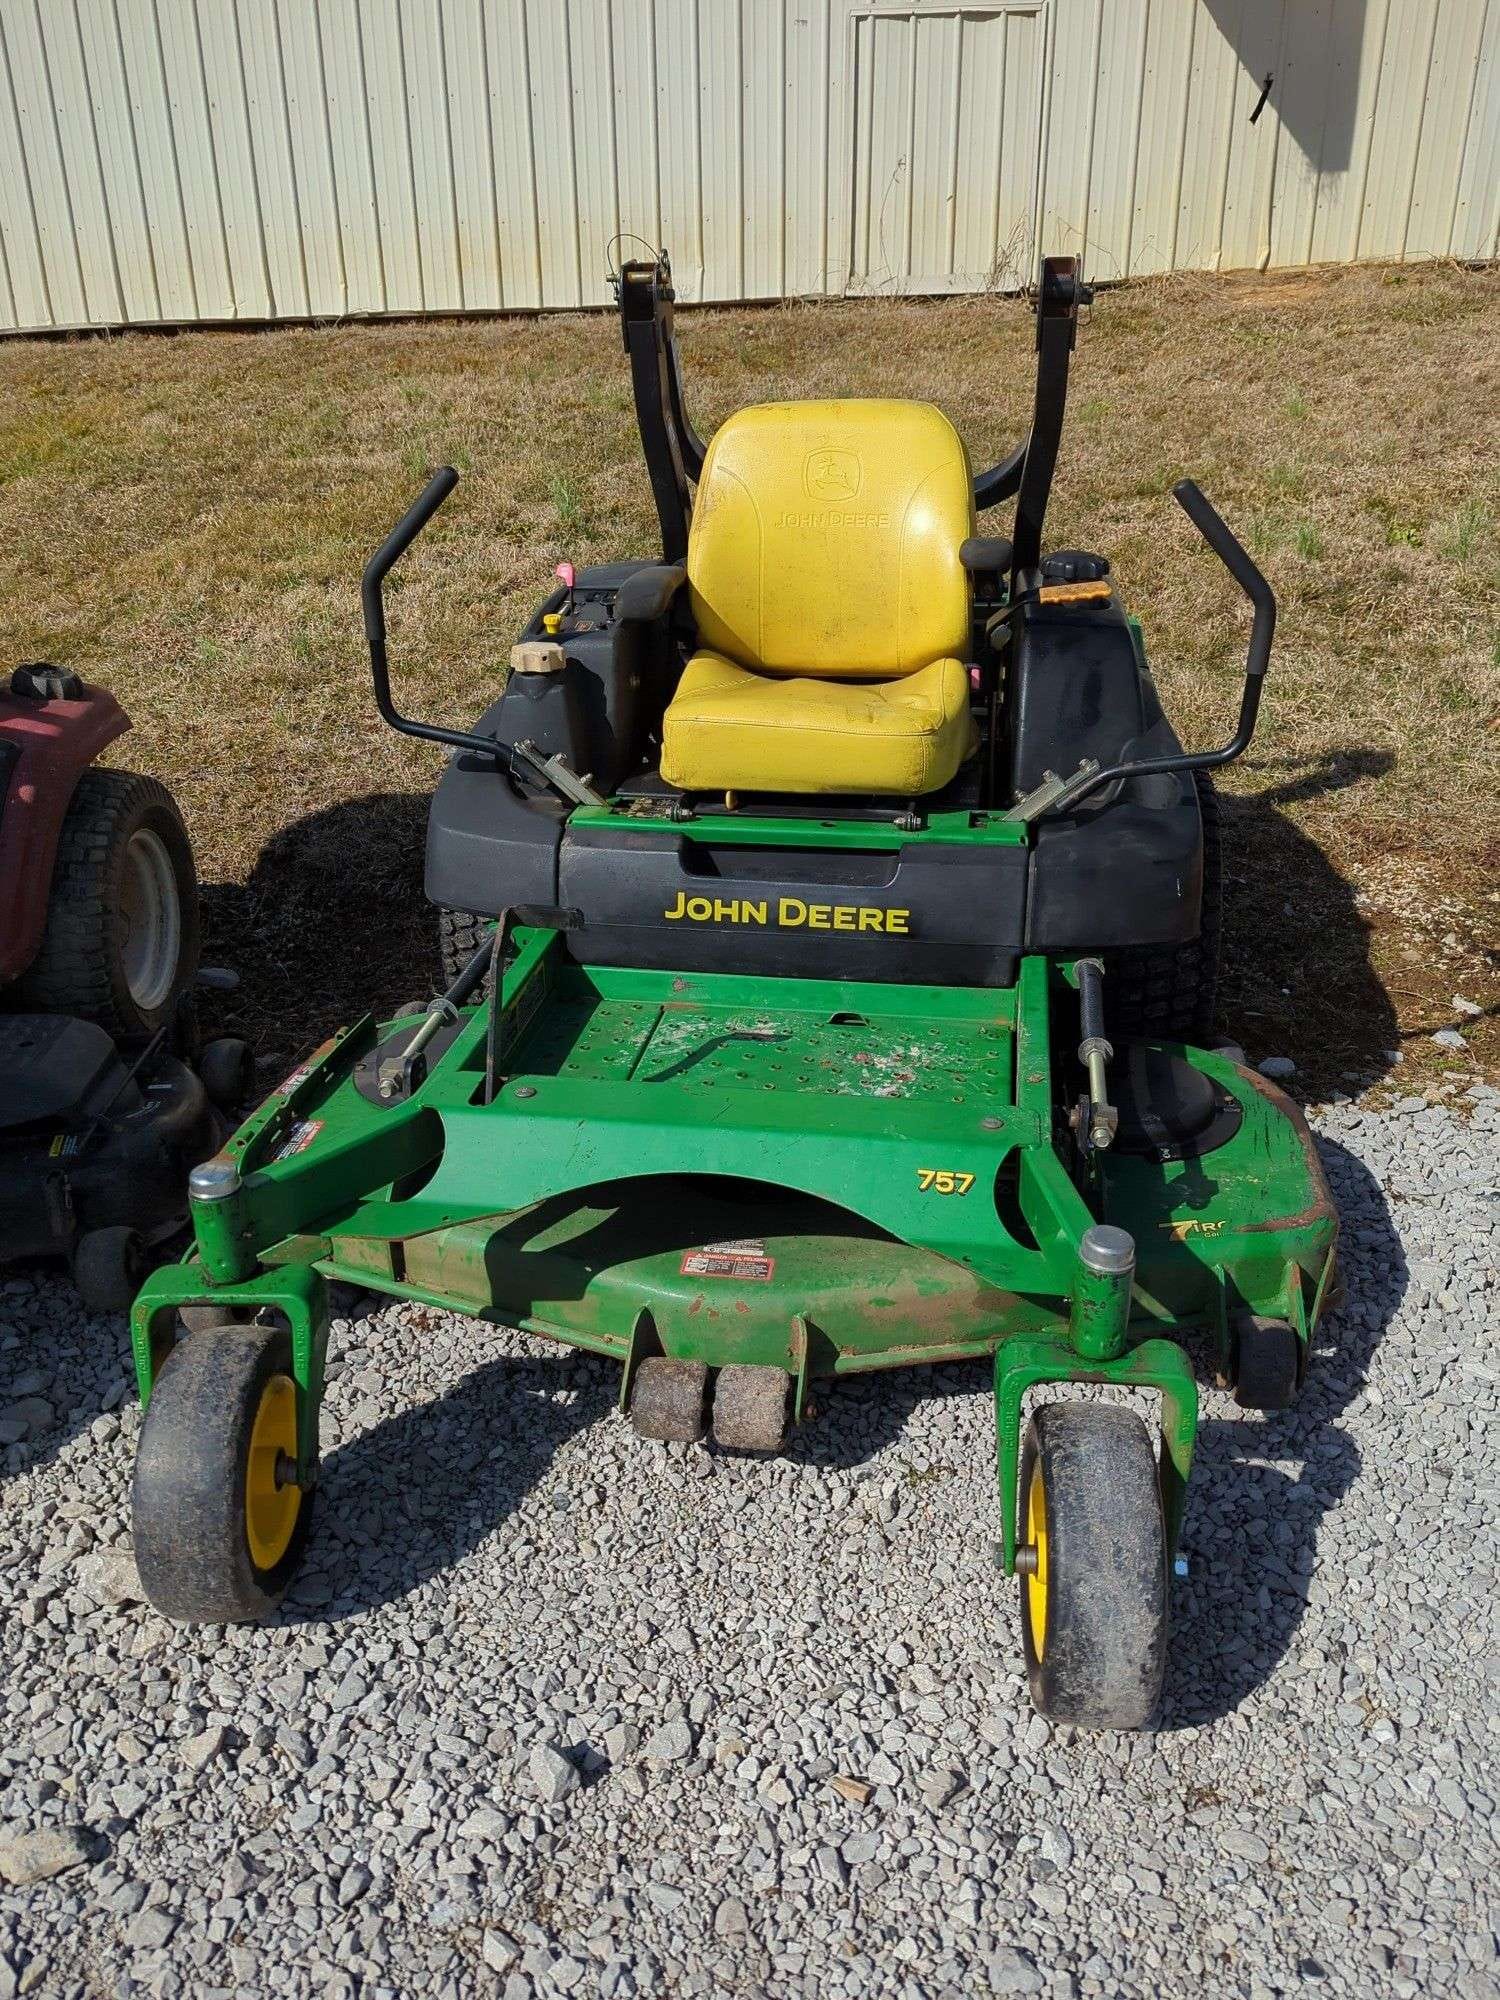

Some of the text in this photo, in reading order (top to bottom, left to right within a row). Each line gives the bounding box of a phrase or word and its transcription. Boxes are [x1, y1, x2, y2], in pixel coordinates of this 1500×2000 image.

[774, 511, 889, 528] JOHN DEERE
[664, 891, 910, 933] JOHN DEERE
[917, 1168, 976, 1196] 757
